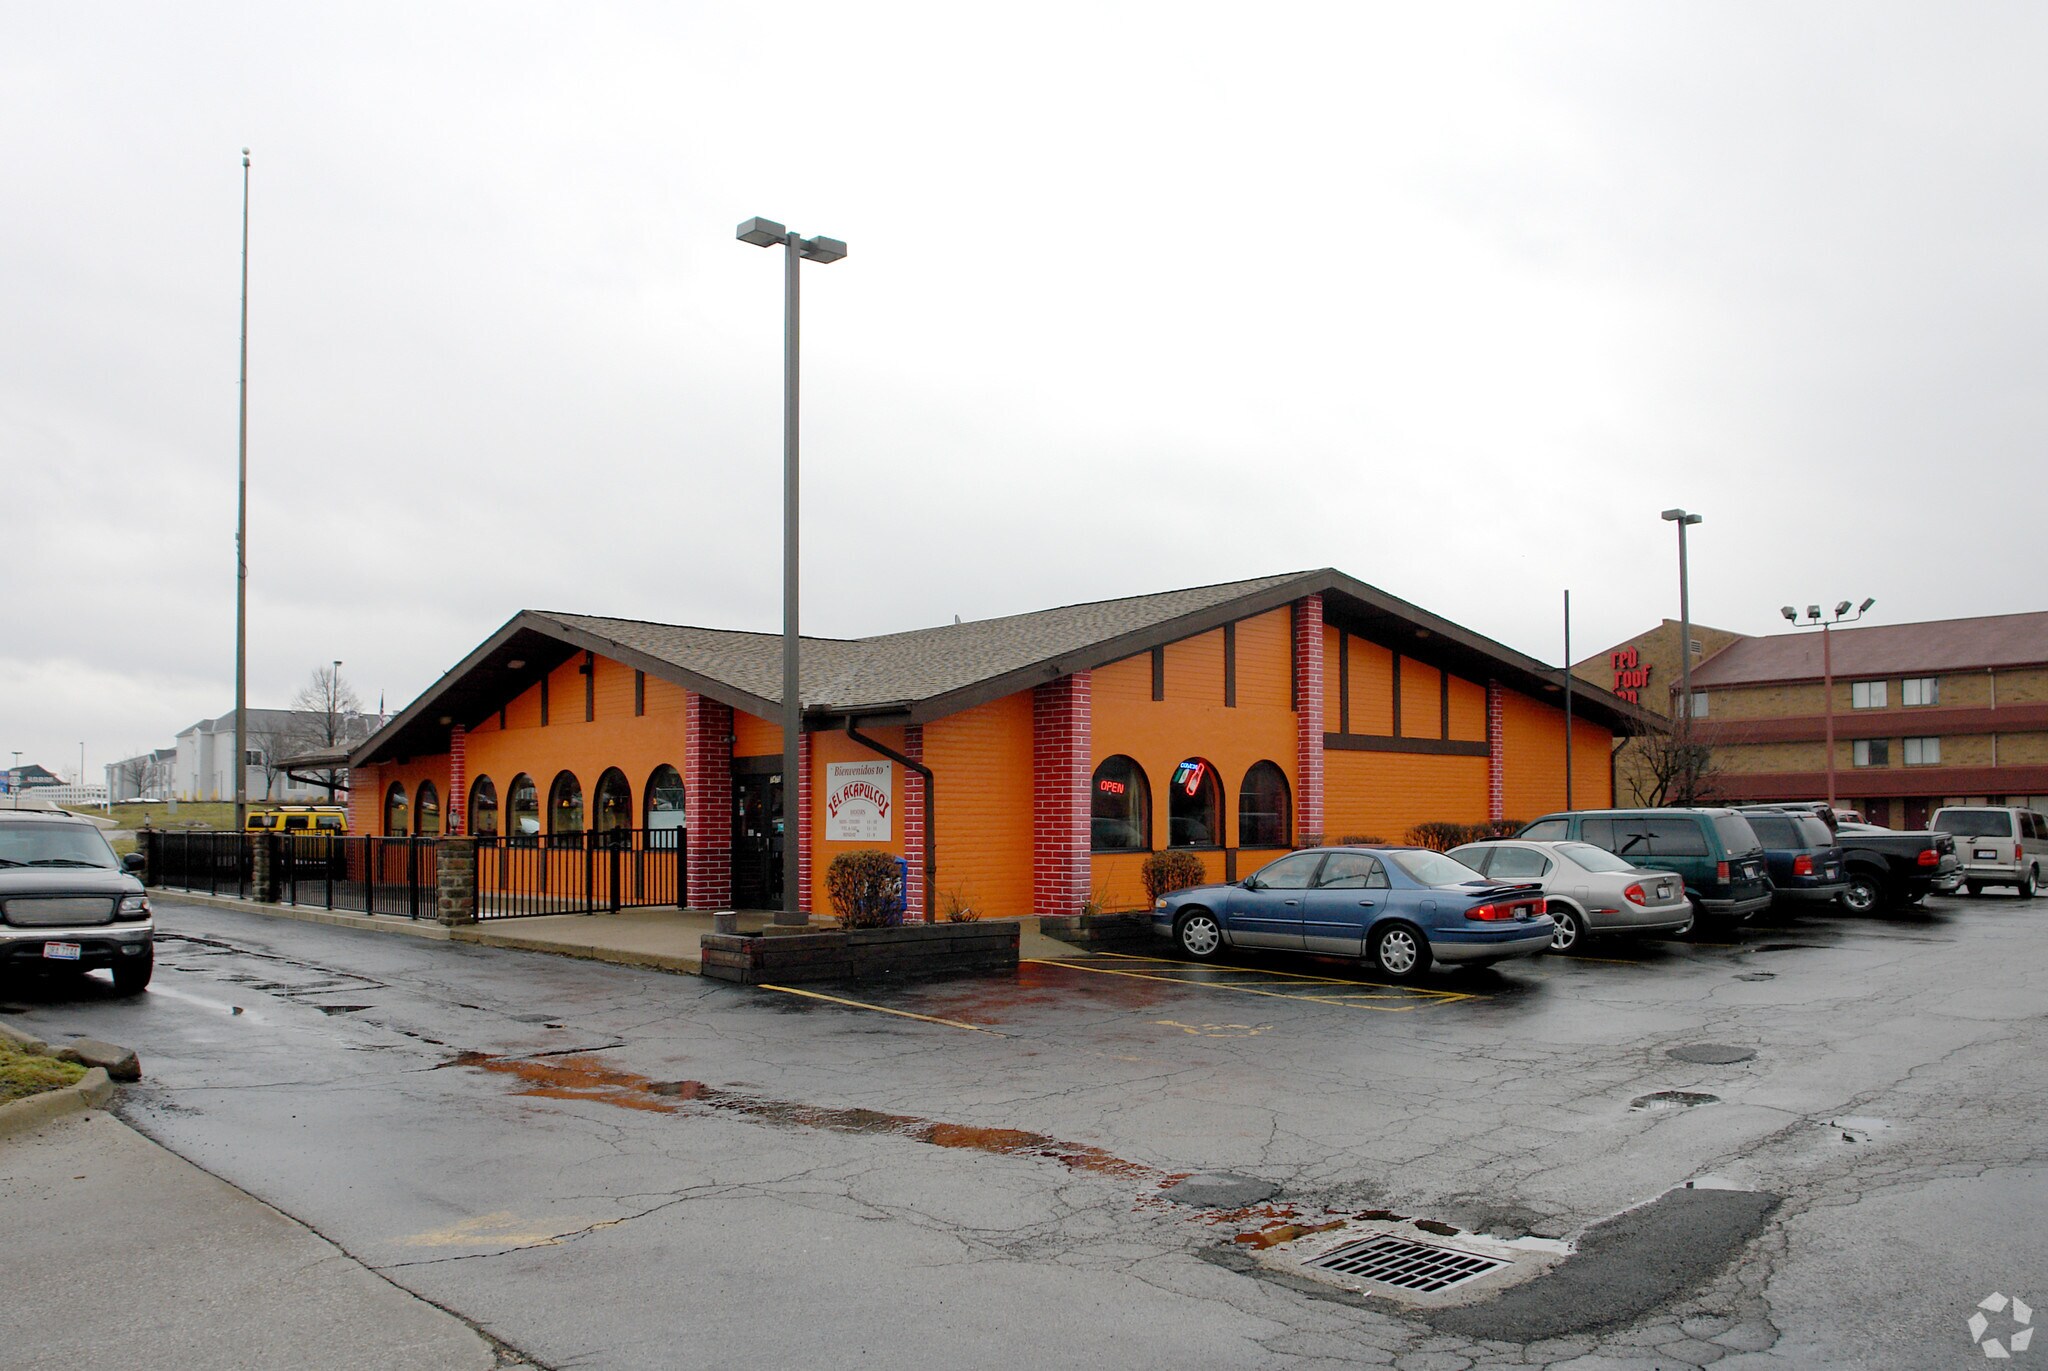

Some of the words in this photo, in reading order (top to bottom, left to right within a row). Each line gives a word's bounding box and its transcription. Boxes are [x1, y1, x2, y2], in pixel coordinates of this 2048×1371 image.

[1610, 646, 1637, 669] red
[1614, 663, 1652, 688] roof
[834, 765, 875, 777] Bienvenidos
[875, 766, 883, 775] to
[831, 792, 842, 808] EL
[843, 783, 885, 807] ACAPULCO
[1100, 780, 1124, 794] OPEN
